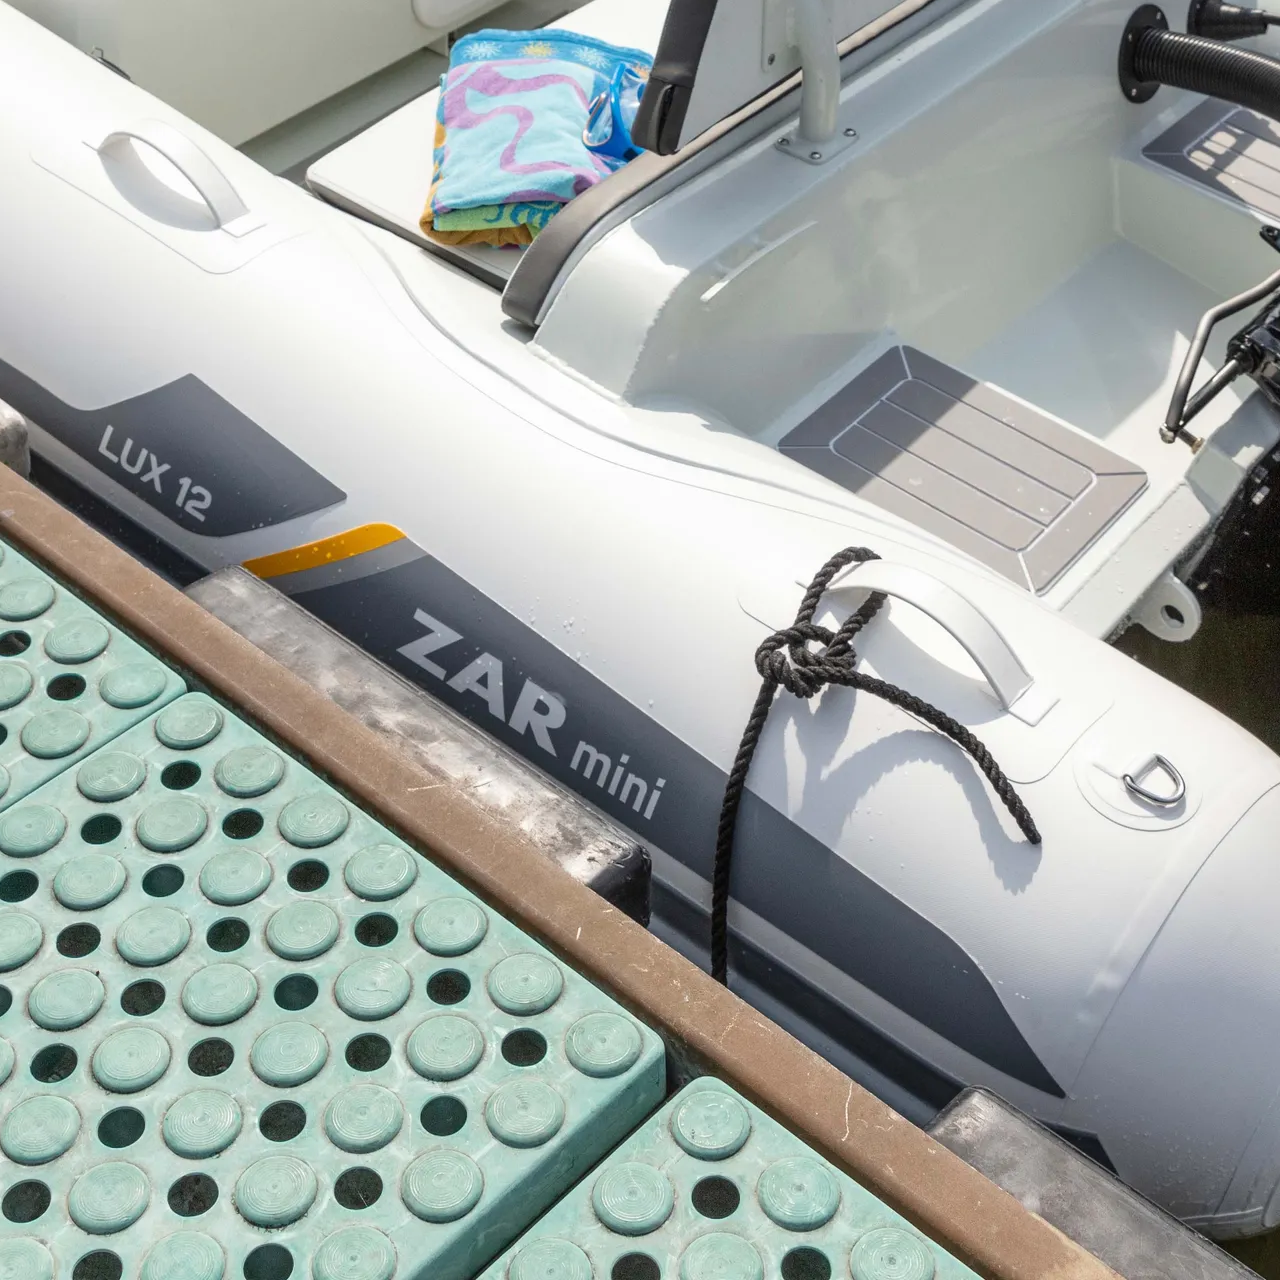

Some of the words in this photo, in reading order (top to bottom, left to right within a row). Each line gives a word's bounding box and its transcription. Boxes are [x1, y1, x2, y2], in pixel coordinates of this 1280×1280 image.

[98, 424, 172, 494] LUX
[175, 476, 212, 522] 12
[396, 608, 567, 757] ZAR
[570, 739, 667, 820] mini
